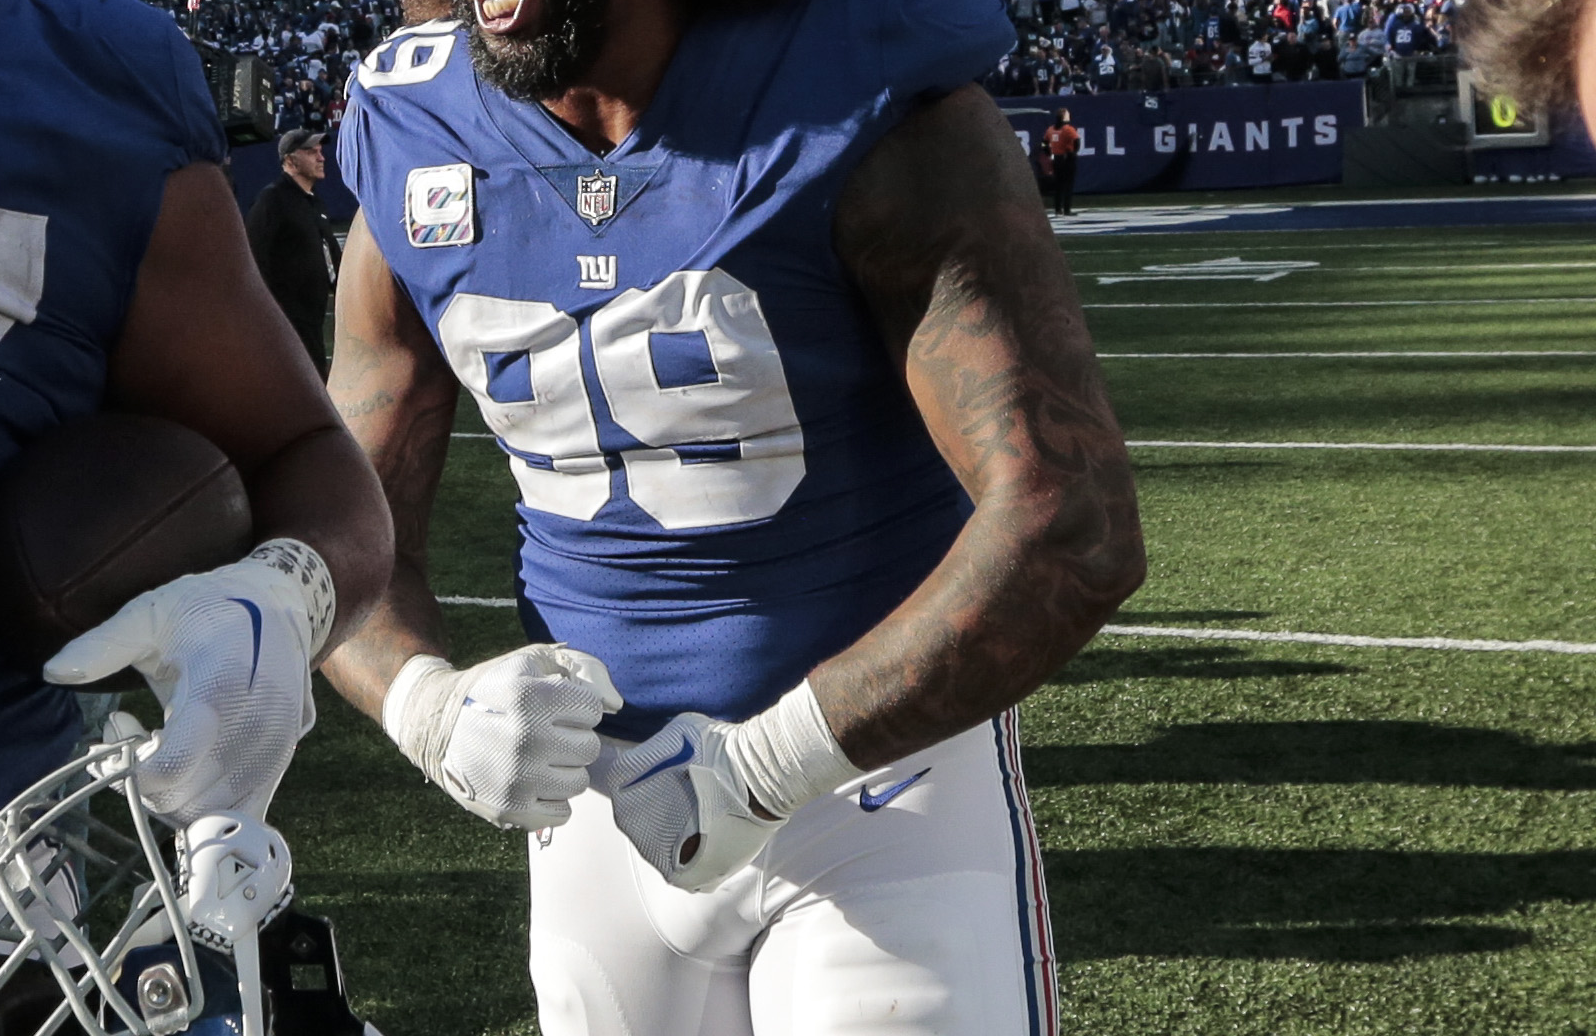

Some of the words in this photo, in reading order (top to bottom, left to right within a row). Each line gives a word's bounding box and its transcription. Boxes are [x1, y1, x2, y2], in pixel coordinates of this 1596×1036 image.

[1395, 29, 1413, 44] 26
[1154, 114, 1338, 154] GIANTS
[411, 170, 467, 225] C
[582, 193, 610, 213] NFL
[576, 255, 617, 290] ny
[438, 267, 807, 531] 99
